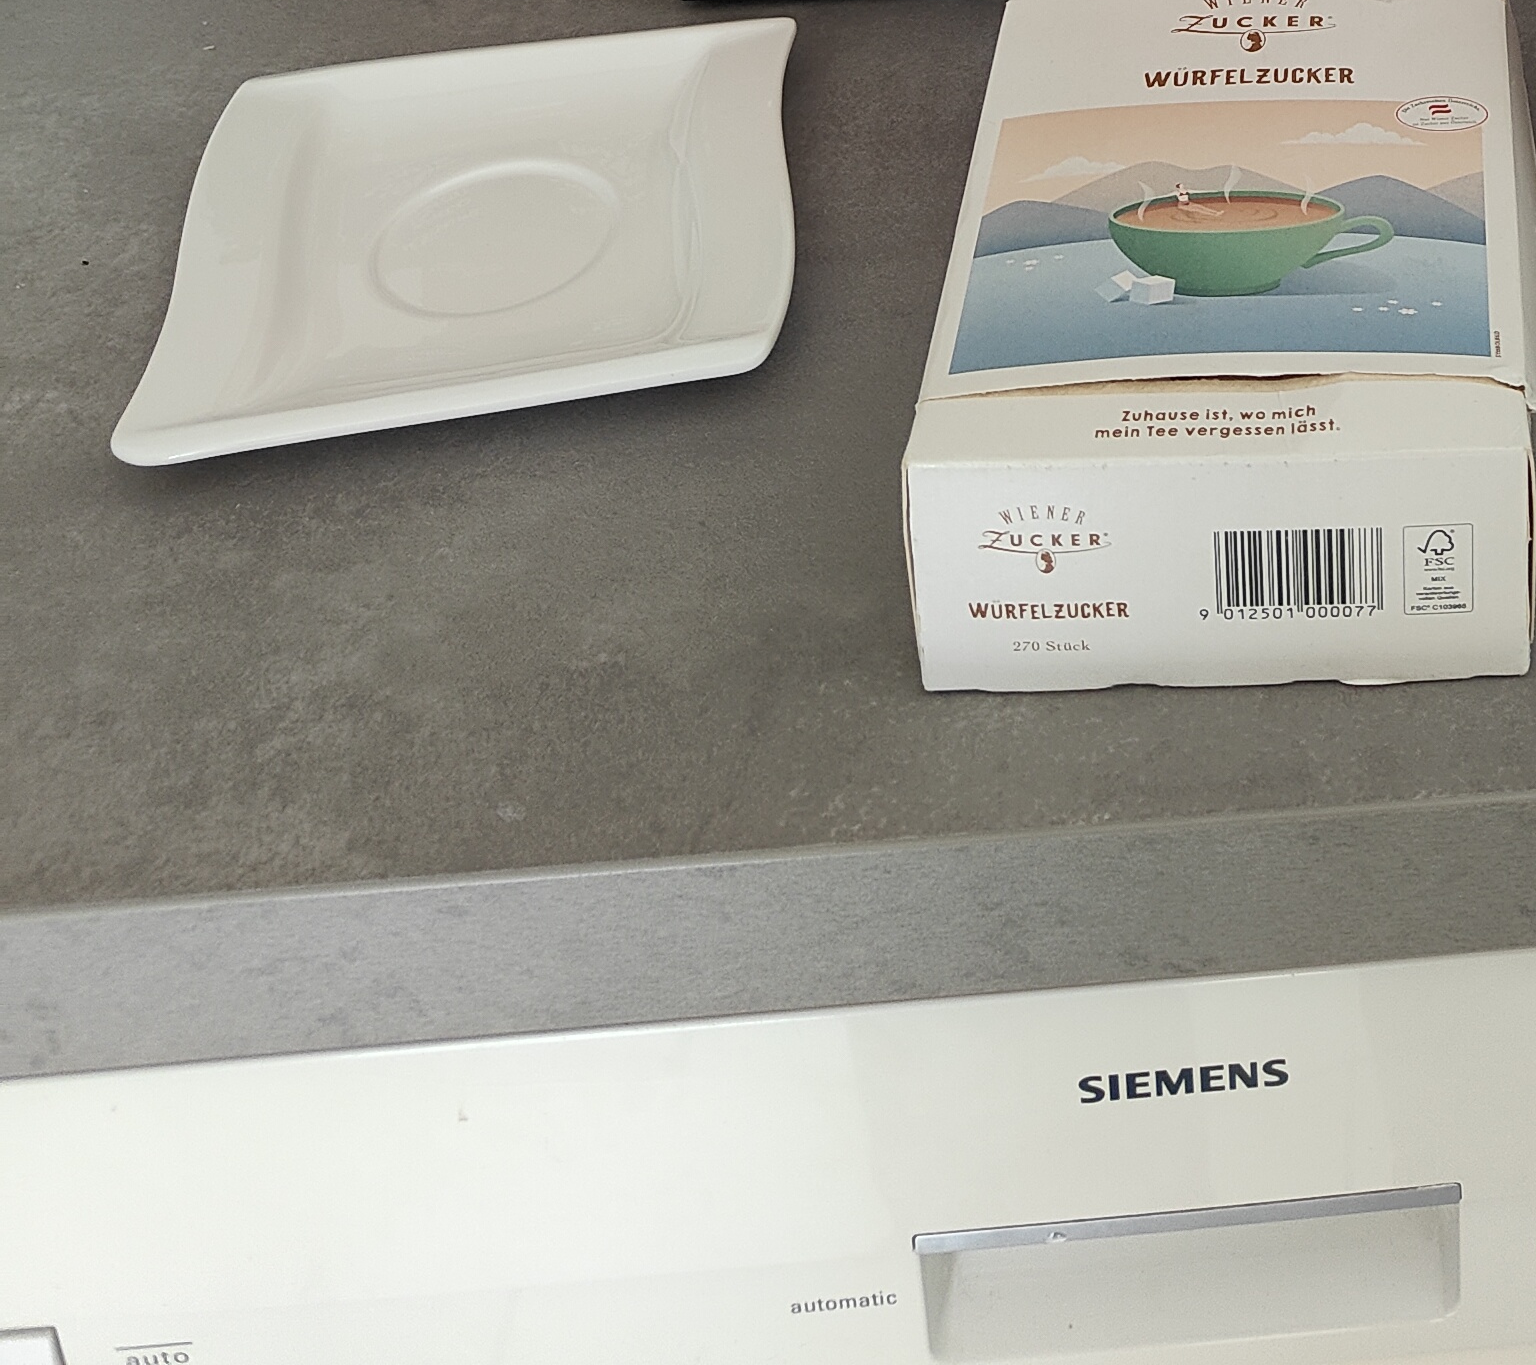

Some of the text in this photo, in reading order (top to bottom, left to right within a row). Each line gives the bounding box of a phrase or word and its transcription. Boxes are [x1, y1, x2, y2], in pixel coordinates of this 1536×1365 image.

[1174, 14, 1327, 34] ZUCKER
[1144, 66, 1355, 89] WÜRFELZUCKER
[1121, 405, 1316, 422] Zuhause ist, wo mich
[1094, 418, 1341, 439] mein Tee vergessen lässt.
[998, 505, 1086, 525] WIENER
[979, 530, 1101, 549] ZUCKER
[1424, 557, 1455, 566] FSC
[968, 600, 1130, 620] WÜRFELZUCKER
[1200, 605, 1377, 620] 9 012501 000077
[1013, 639, 1090, 652] 270 Stück
[1077, 1058, 1290, 1104] SIEMENS
[790, 1290, 898, 1316] automatic
[126, 1351, 190, 1365] auto
